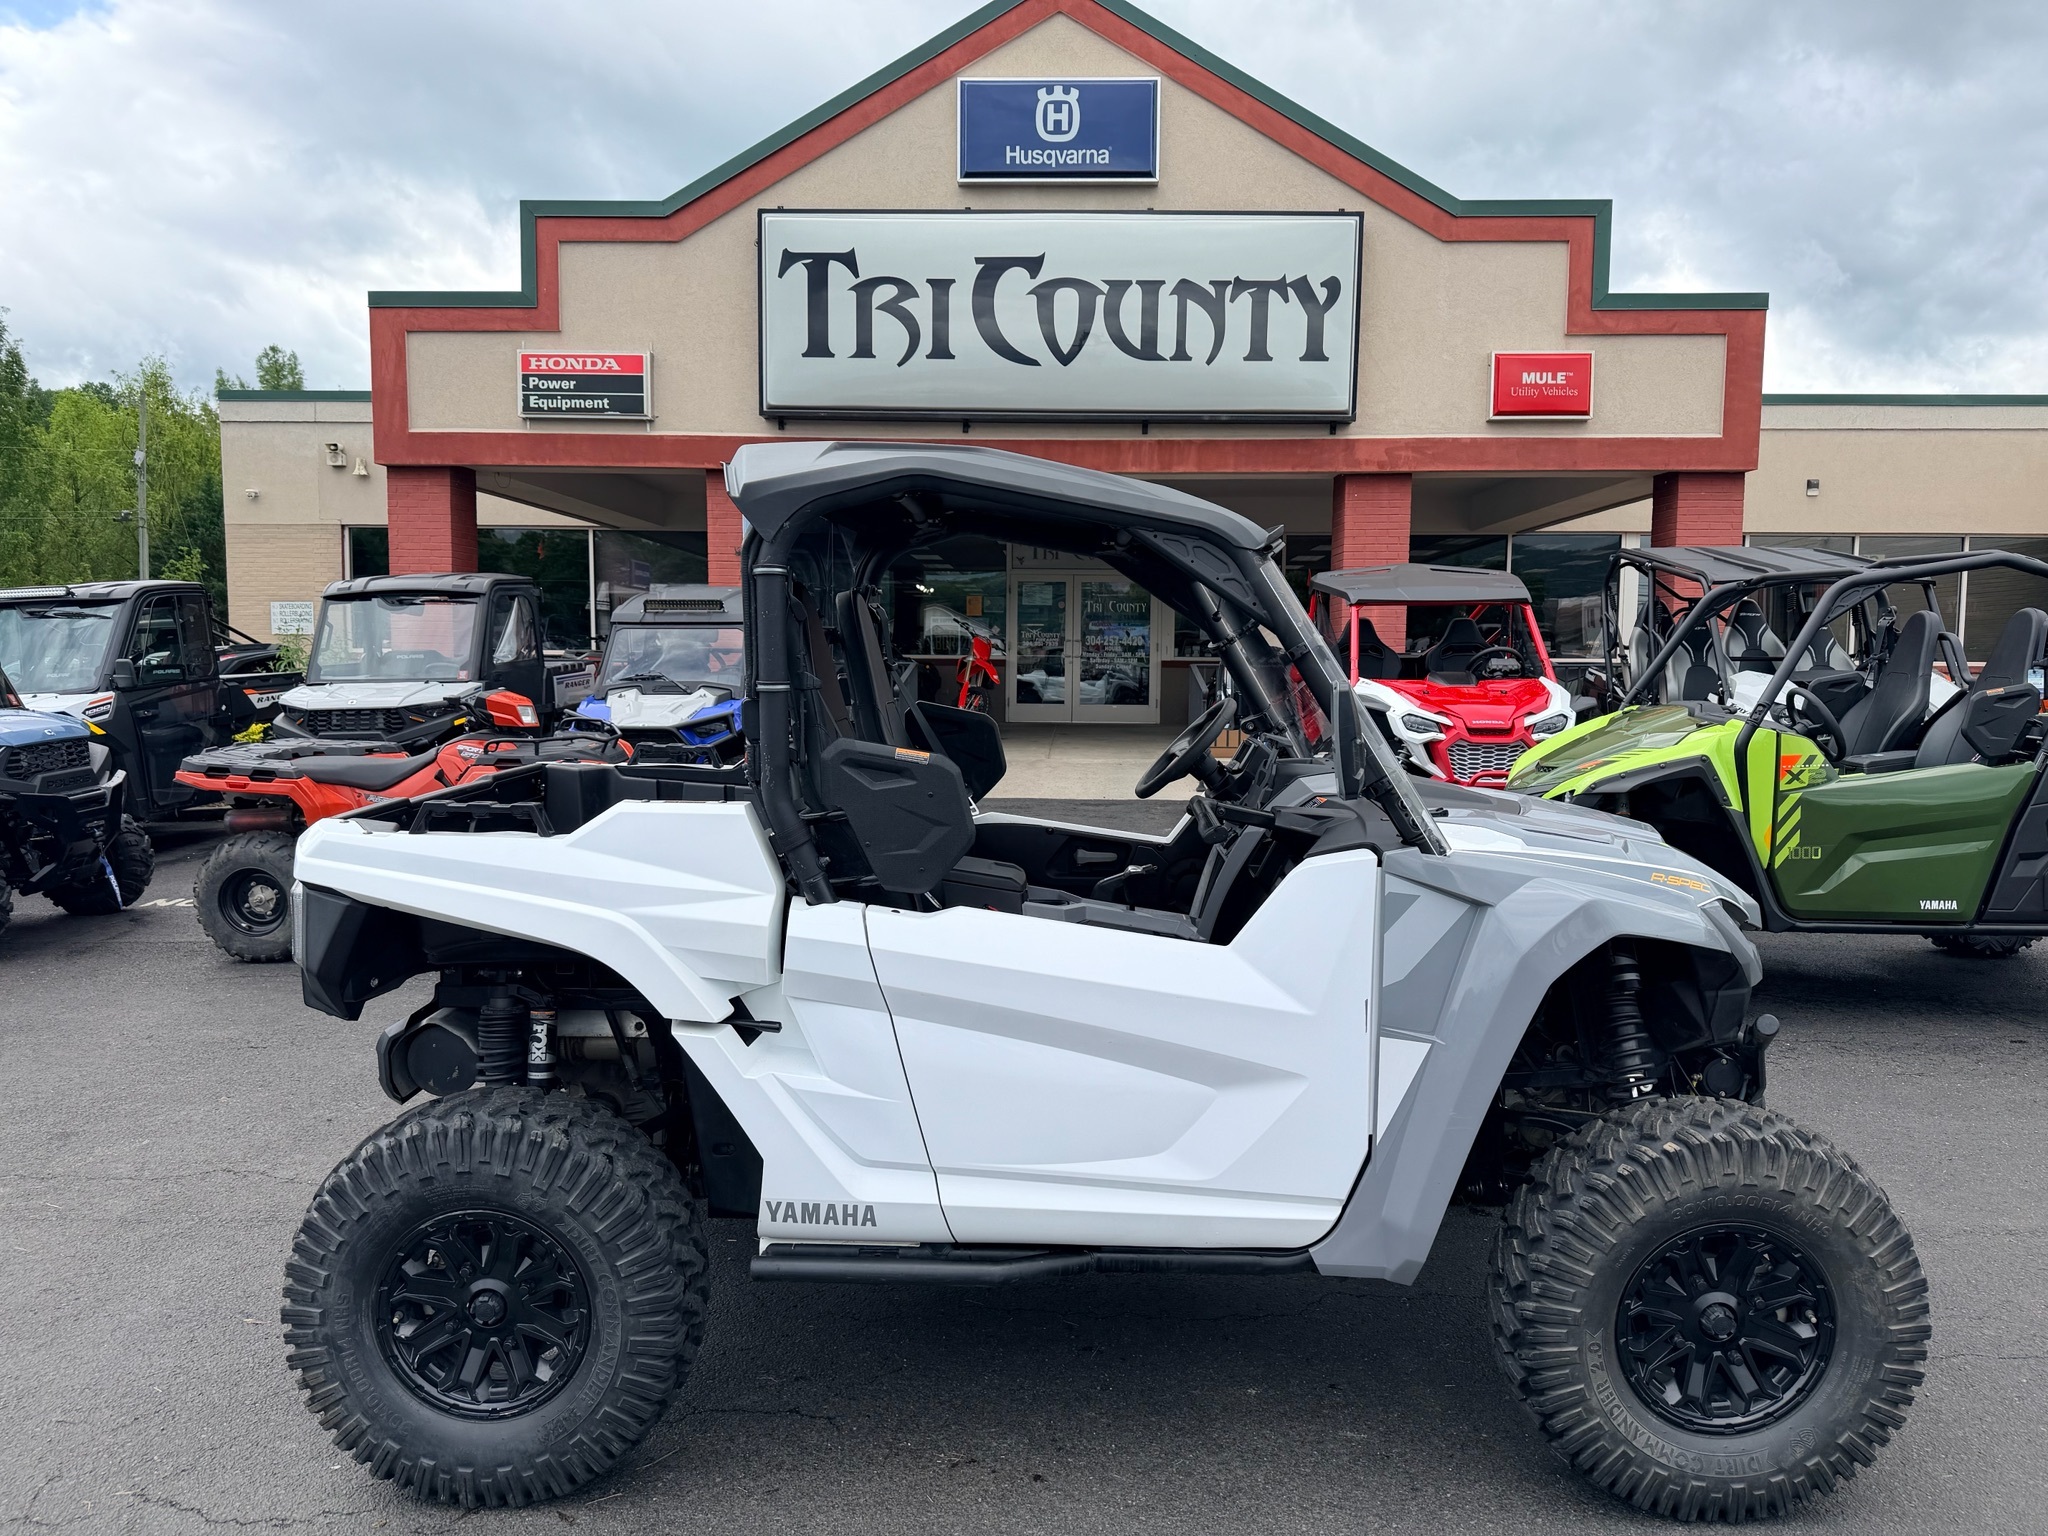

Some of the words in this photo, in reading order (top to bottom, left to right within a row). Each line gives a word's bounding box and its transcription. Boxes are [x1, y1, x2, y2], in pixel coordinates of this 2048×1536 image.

[528, 357, 621, 370] HONDA
[528, 376, 577, 390] Power
[1510, 386, 1540, 398] Utility
[1541, 386, 1579, 396] Vehicles
[528, 395, 610, 411] Equipment
[1085, 600, 1102, 613] TRI
[1109, 600, 1147, 613] COUNTY
[1085, 635, 1143, 646] 304-257-4420
[564, 678, 591, 689] RANGER
[85, 703, 111, 716] 1000
[46, 775, 92, 789] POLARIS
[1787, 846, 1822, 860] 1000
[1919, 900, 1958, 910] YAMAHA
[530, 1023, 548, 1062] FOX
[765, 1200, 877, 1227] YAMAHA
[1587, 1341, 1606, 1375] 2.0
[1595, 1378, 1705, 1473] COMMANDER
[1714, 1455, 1762, 1475] DIRT
